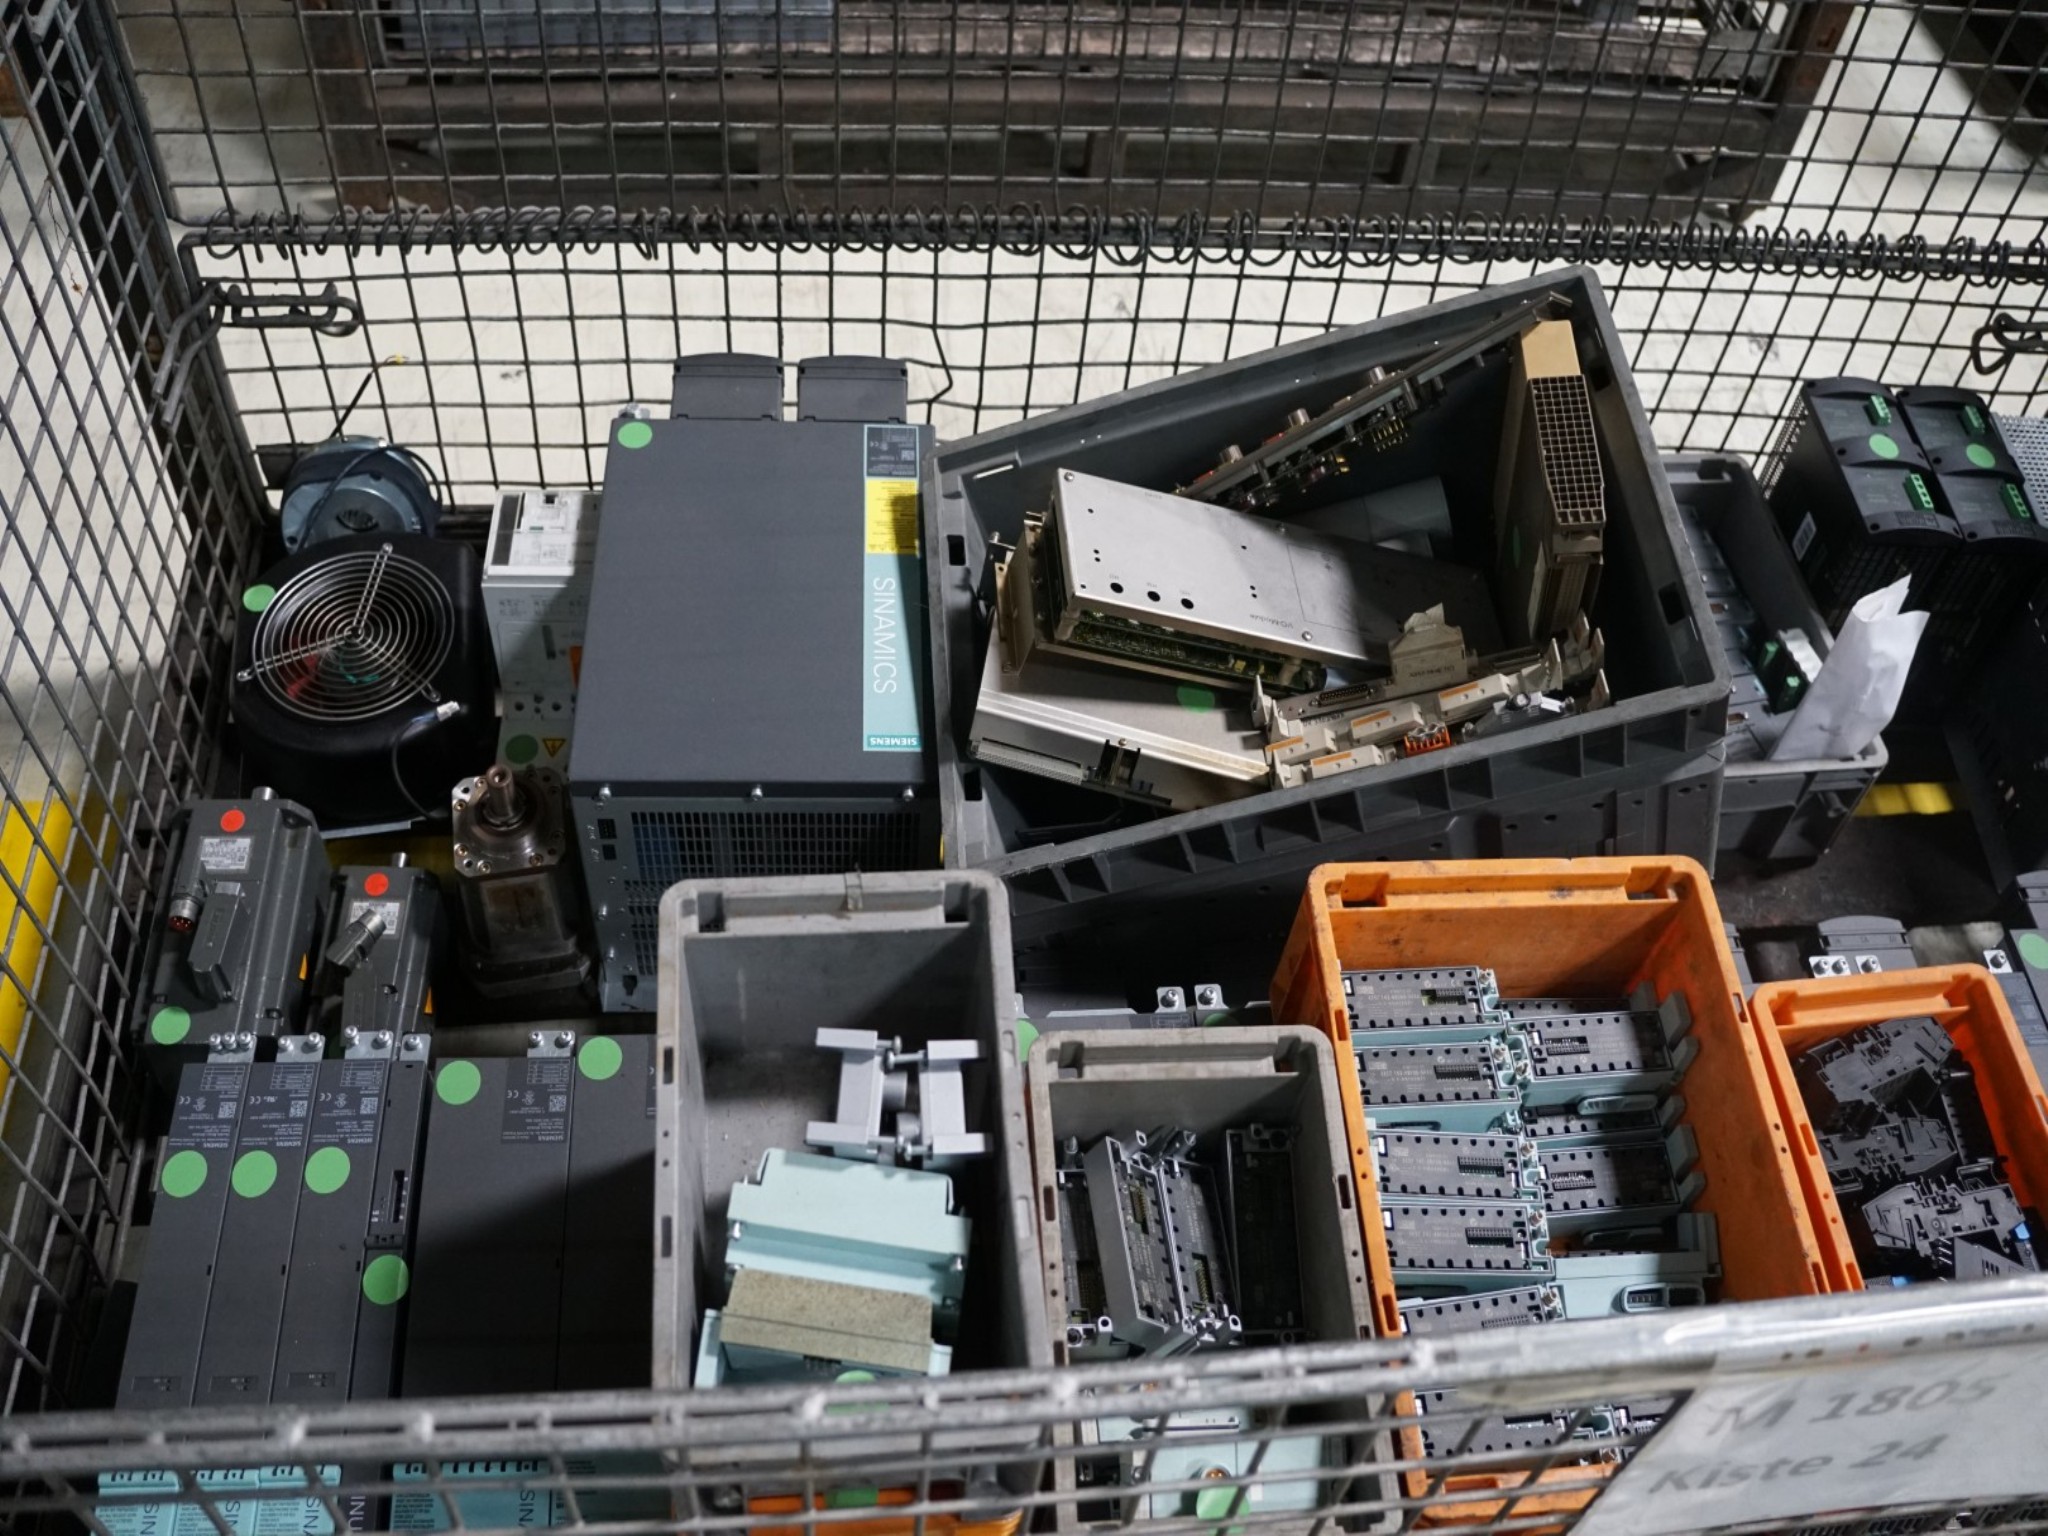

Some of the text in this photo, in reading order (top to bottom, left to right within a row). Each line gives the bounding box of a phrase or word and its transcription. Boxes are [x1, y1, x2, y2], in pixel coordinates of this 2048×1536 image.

[873, 577, 897, 694] SINAMICS
[870, 737, 918, 746] SIEMENS
[1706, 1372, 2010, 1436] M 1805
[1647, 1432, 1950, 1494] Kiste 24
